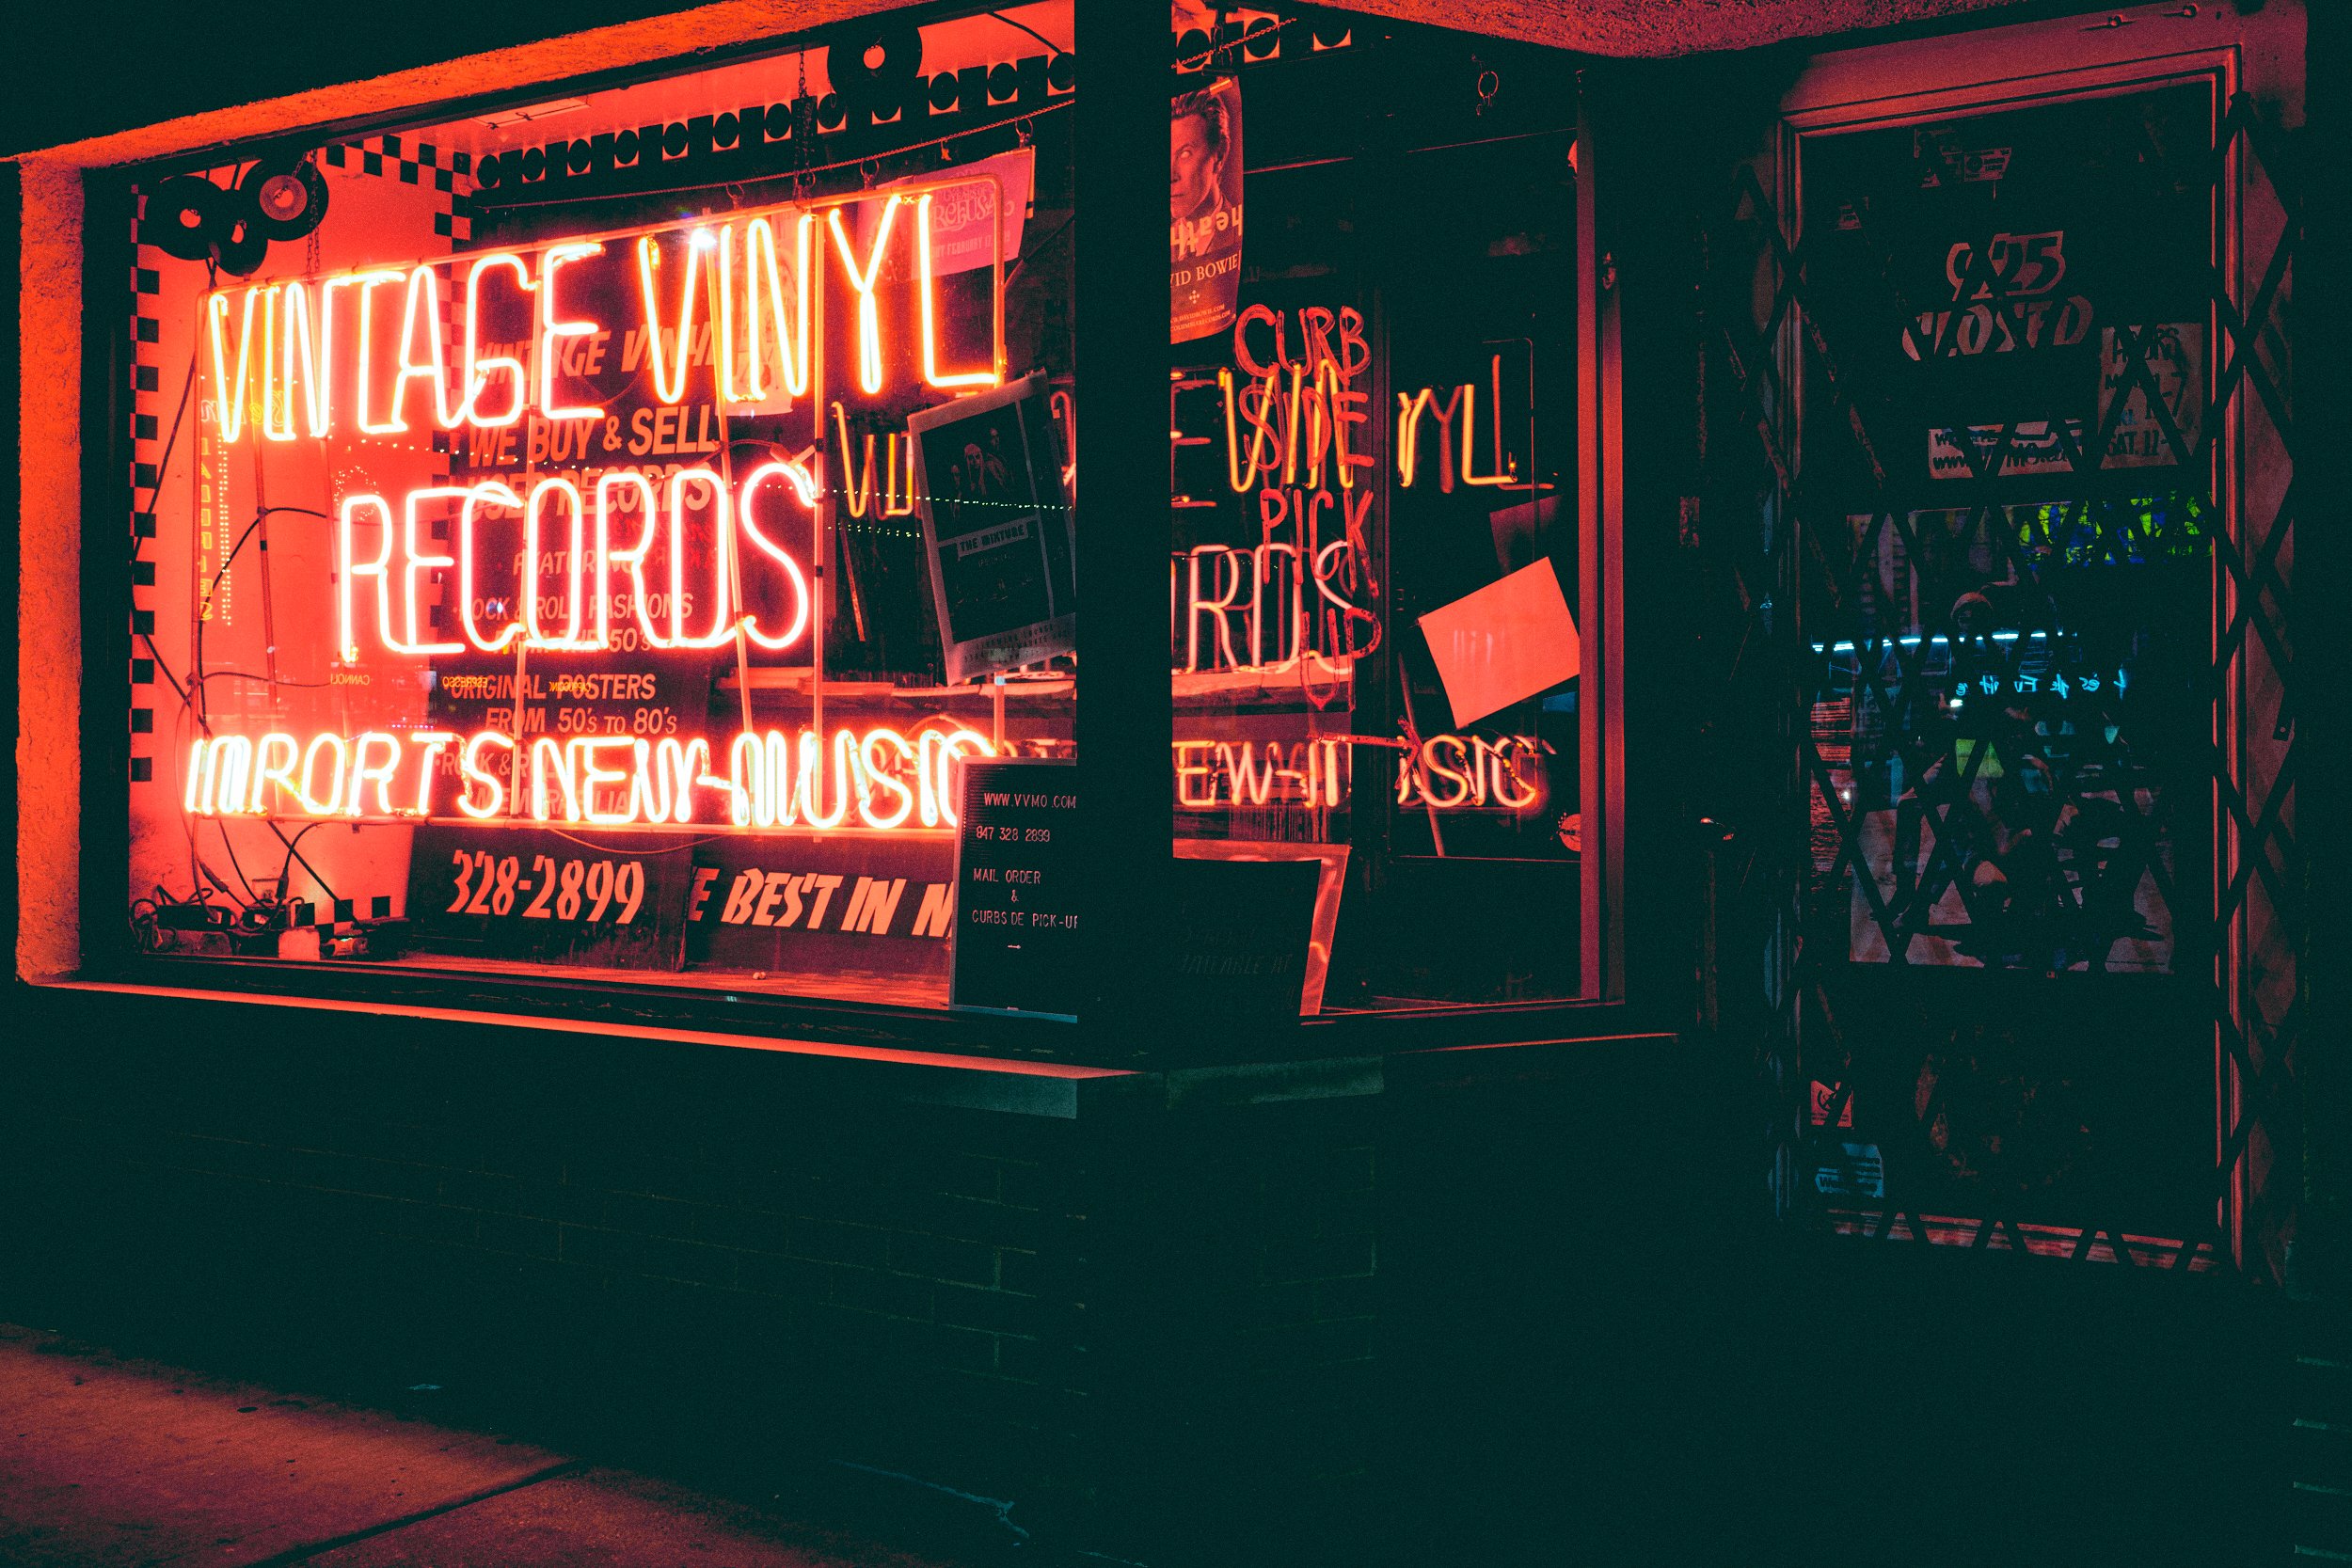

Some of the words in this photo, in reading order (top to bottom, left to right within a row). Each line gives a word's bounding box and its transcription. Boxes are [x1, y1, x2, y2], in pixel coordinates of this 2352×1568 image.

[1196, 253, 1238, 282] BOWIE
[209, 243, 605, 443] VINTAGE
[638, 194, 999, 404] VINYL
[1234, 304, 1372, 386] CURB
[469, 420, 519, 468] WE
[531, 417, 596, 464] BUY
[603, 414, 622, 451] &
[628, 404, 720, 457] SELL
[1239, 387, 1375, 470] SIDE
[340, 462, 818, 662] RECORDS
[960, 536, 978, 552] THE
[1261, 488, 1378, 597] PICK
[451, 674, 547, 700] ORIGINAL
[557, 673, 657, 701] POSTERS
[1300, 608, 1382, 711] UP
[485, 707, 545, 734] FROM
[557, 705, 597, 734] 50's
[604, 717, 627, 734] TO
[632, 705, 677, 735] 80's
[184, 731, 514, 819] IMPORTS
[441, 752, 498, 776] ROK
[499, 752, 511, 776] &
[976, 825, 994, 841] 847
[999, 827, 1019, 842] 328
[1025, 828, 1051, 843] 2899
[446, 849, 645, 926] 328-2899
[721, 866, 845, 930] BEST
[840, 876, 908, 936] IN
[973, 867, 999, 882] MAIL
[1005, 869, 1041, 884] ORDER
[1010, 889, 1019, 903] &
